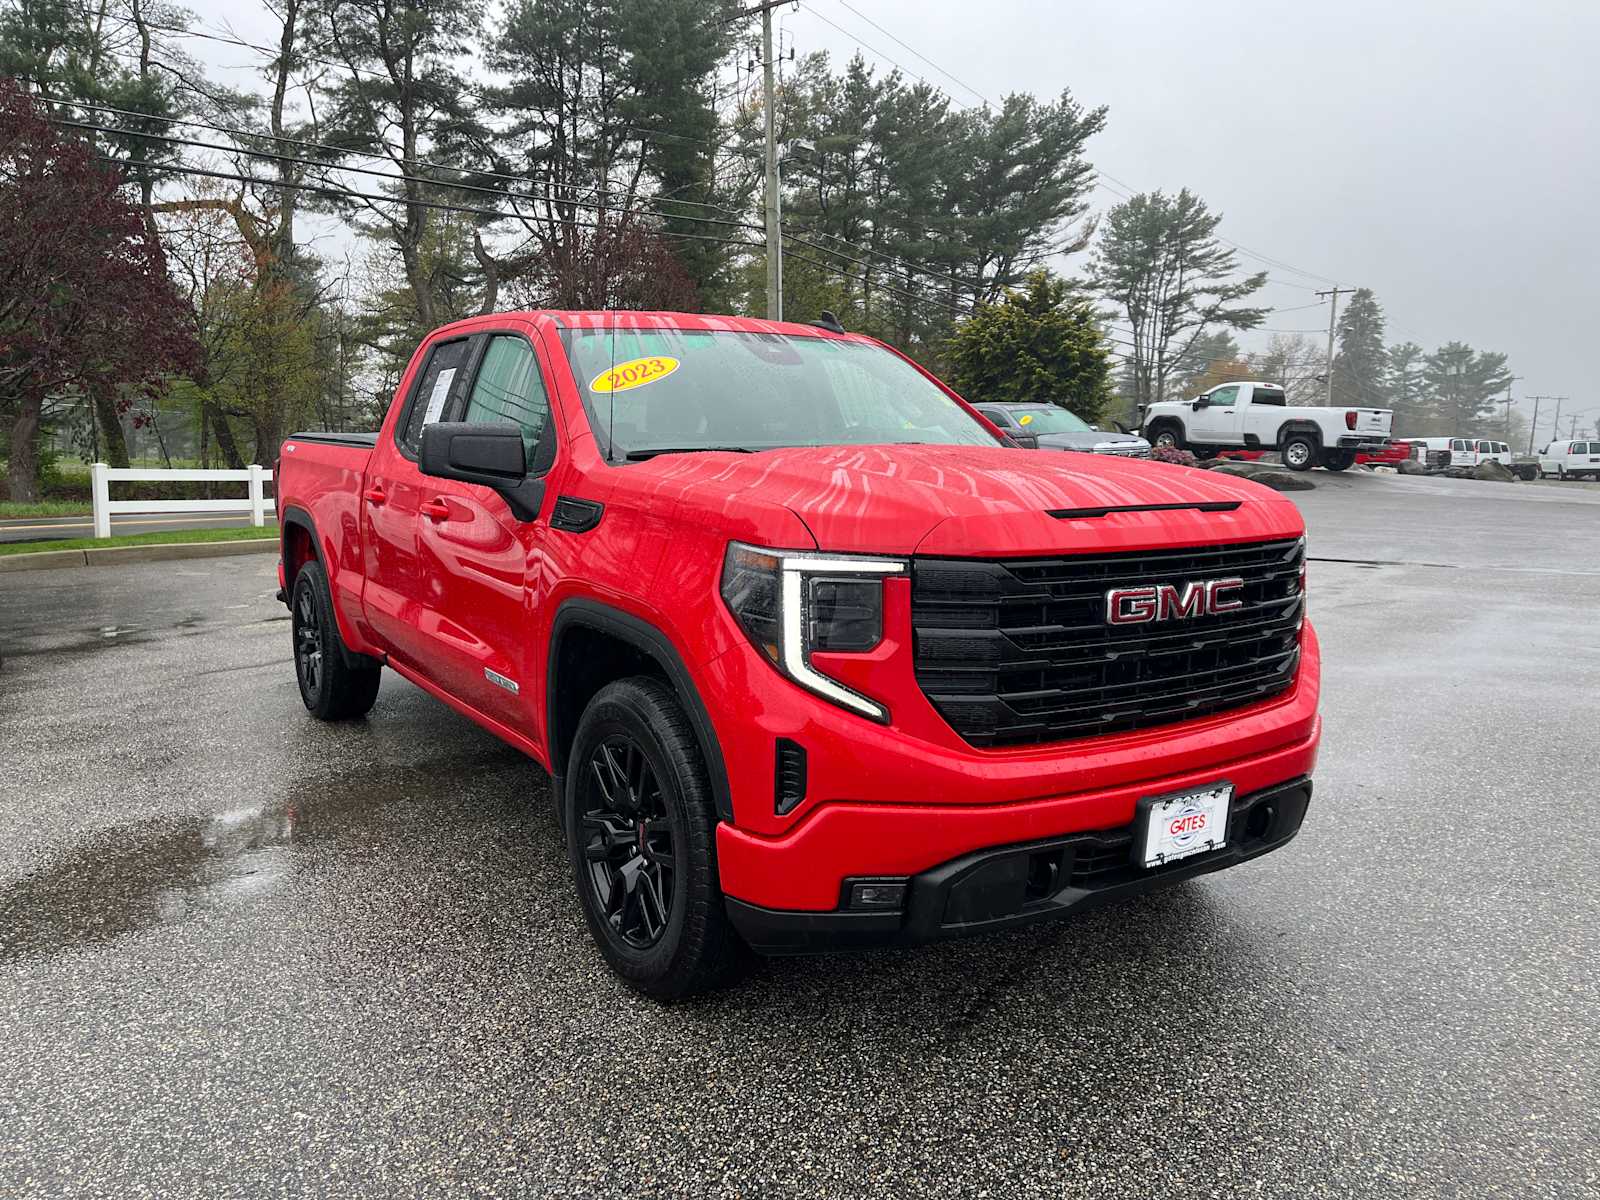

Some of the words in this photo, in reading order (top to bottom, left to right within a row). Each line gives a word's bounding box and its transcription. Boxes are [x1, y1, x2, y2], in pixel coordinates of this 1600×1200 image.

[608, 360, 665, 388] 2023
[1107, 578, 1244, 625] GMC
[1170, 814, 1205, 835] GATES
